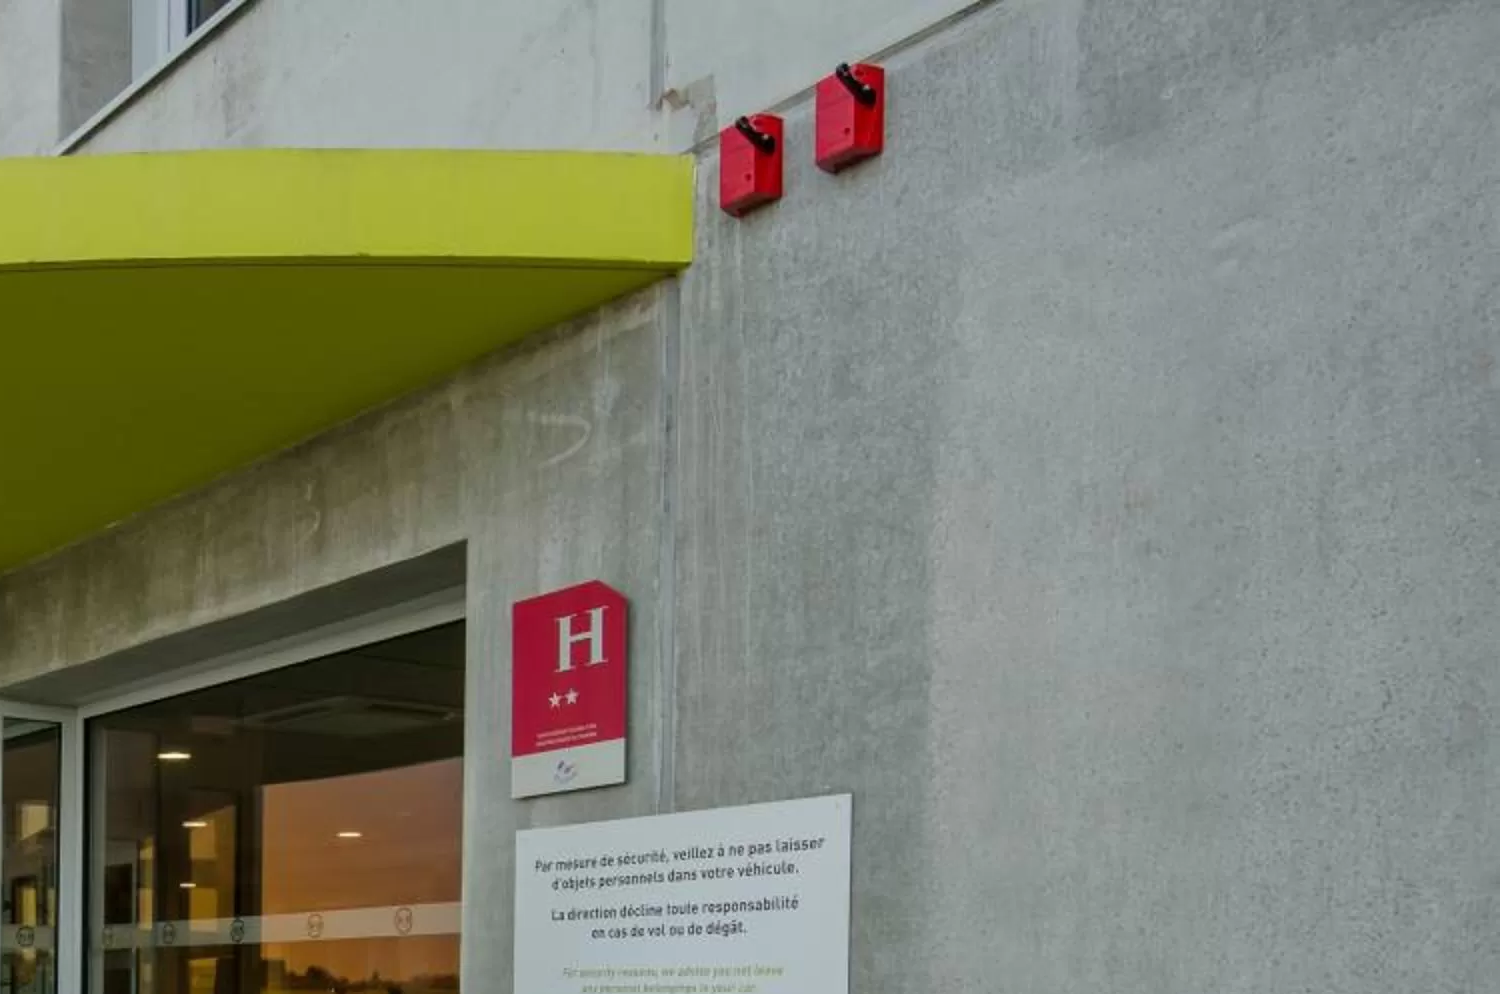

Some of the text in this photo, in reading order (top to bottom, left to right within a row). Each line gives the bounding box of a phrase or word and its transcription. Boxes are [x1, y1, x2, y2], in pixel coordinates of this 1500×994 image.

[553, 605, 610, 673] H
[535, 837, 825, 872] Par mesure de sécurité, veillez à ne pas laisser
[551, 859, 801, 892] d'objets personnels dans votre véhicule.
[551, 895, 800, 920] La direction décline toute responsabilité
[591, 919, 748, 939] en cas de vol ou de dégât.
